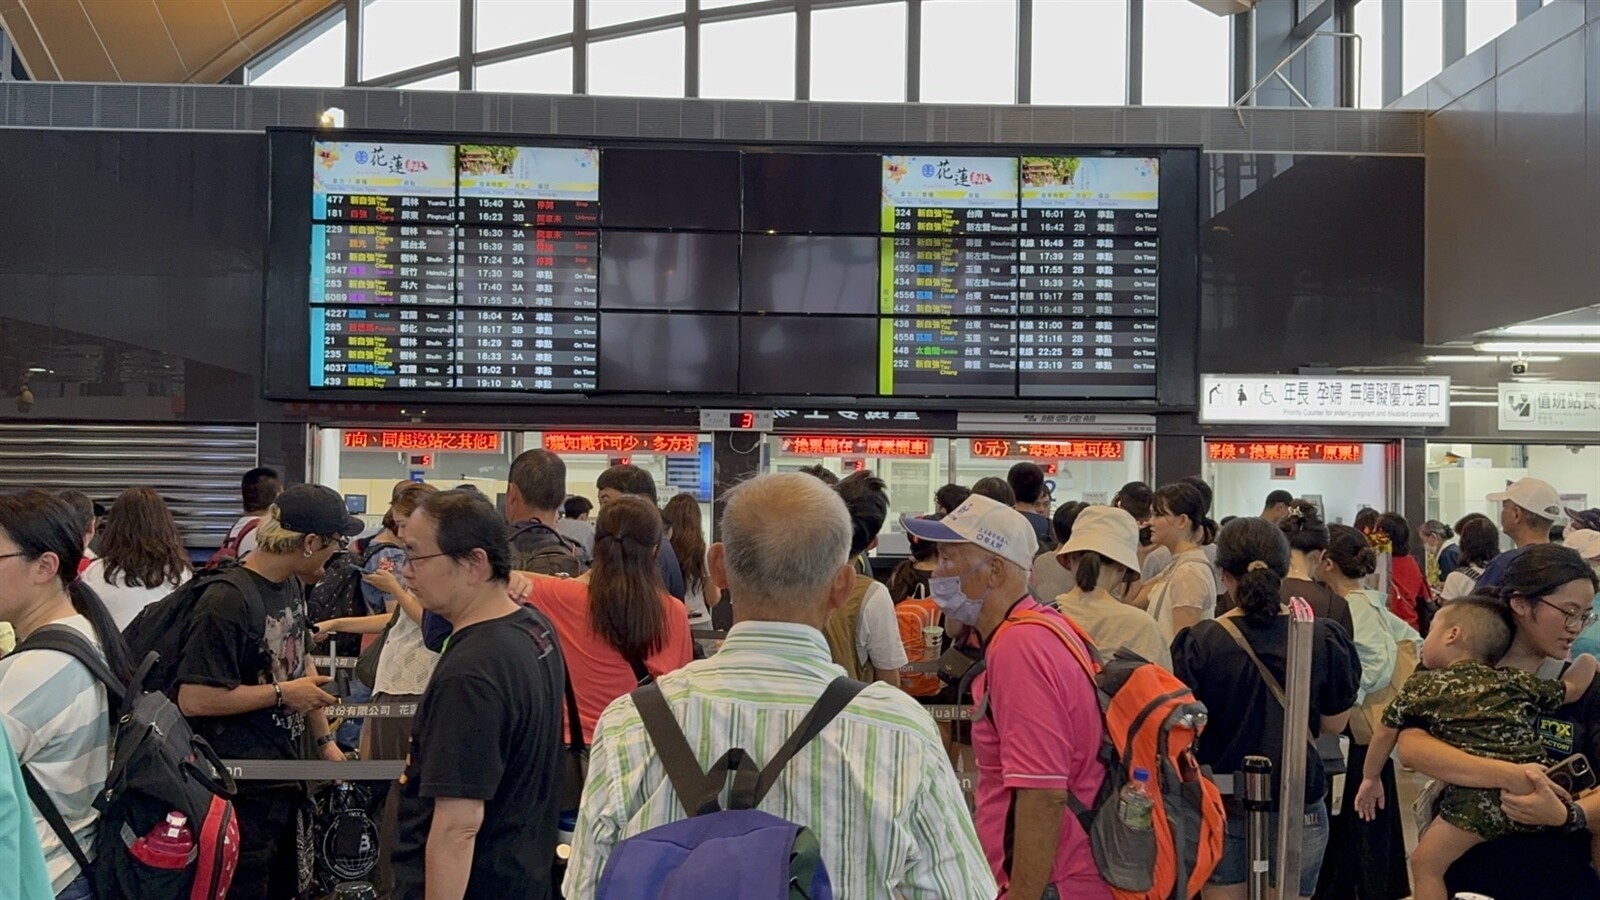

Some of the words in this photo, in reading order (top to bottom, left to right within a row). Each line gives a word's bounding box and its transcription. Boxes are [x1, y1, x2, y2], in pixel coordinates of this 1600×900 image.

[479, 199, 503, 207] 15:40
[479, 212, 503, 221] 16:23
[1040, 210, 1064, 218] 16:01
[1040, 224, 1064, 232] 16:42
[479, 228, 503, 237] 16:30
[478, 242, 503, 250] 16:39
[478, 256, 502, 264] 17:24
[1040, 252, 1063, 260] 17:39
[478, 270, 502, 278] 17:30
[478, 283, 502, 291] 17:40
[1040, 279, 1063, 287] 18:39
[1040, 292, 1063, 300] 19:17
[478, 312, 502, 320] 18:04
[478, 326, 502, 334] 18:17
[1039, 322, 1062, 330] 21:00
[478, 339, 502, 347] 18:29
[1038, 348, 1062, 356] 22:25
[1038, 361, 1062, 369] 23:19
[477, 366, 501, 374] 19:02
[477, 380, 501, 388] 19:10
[1284, 382, 1310, 406] 年長
[1317, 382, 1343, 406] 孕婦
[1350, 383, 1441, 407] 無障礙優先窗口
[741, 412, 754, 429] 3
[324, 704, 391, 716] 股份有限公司
[1540, 719, 1571, 738] FOX
[1542, 739, 1570, 751] ACTORY
